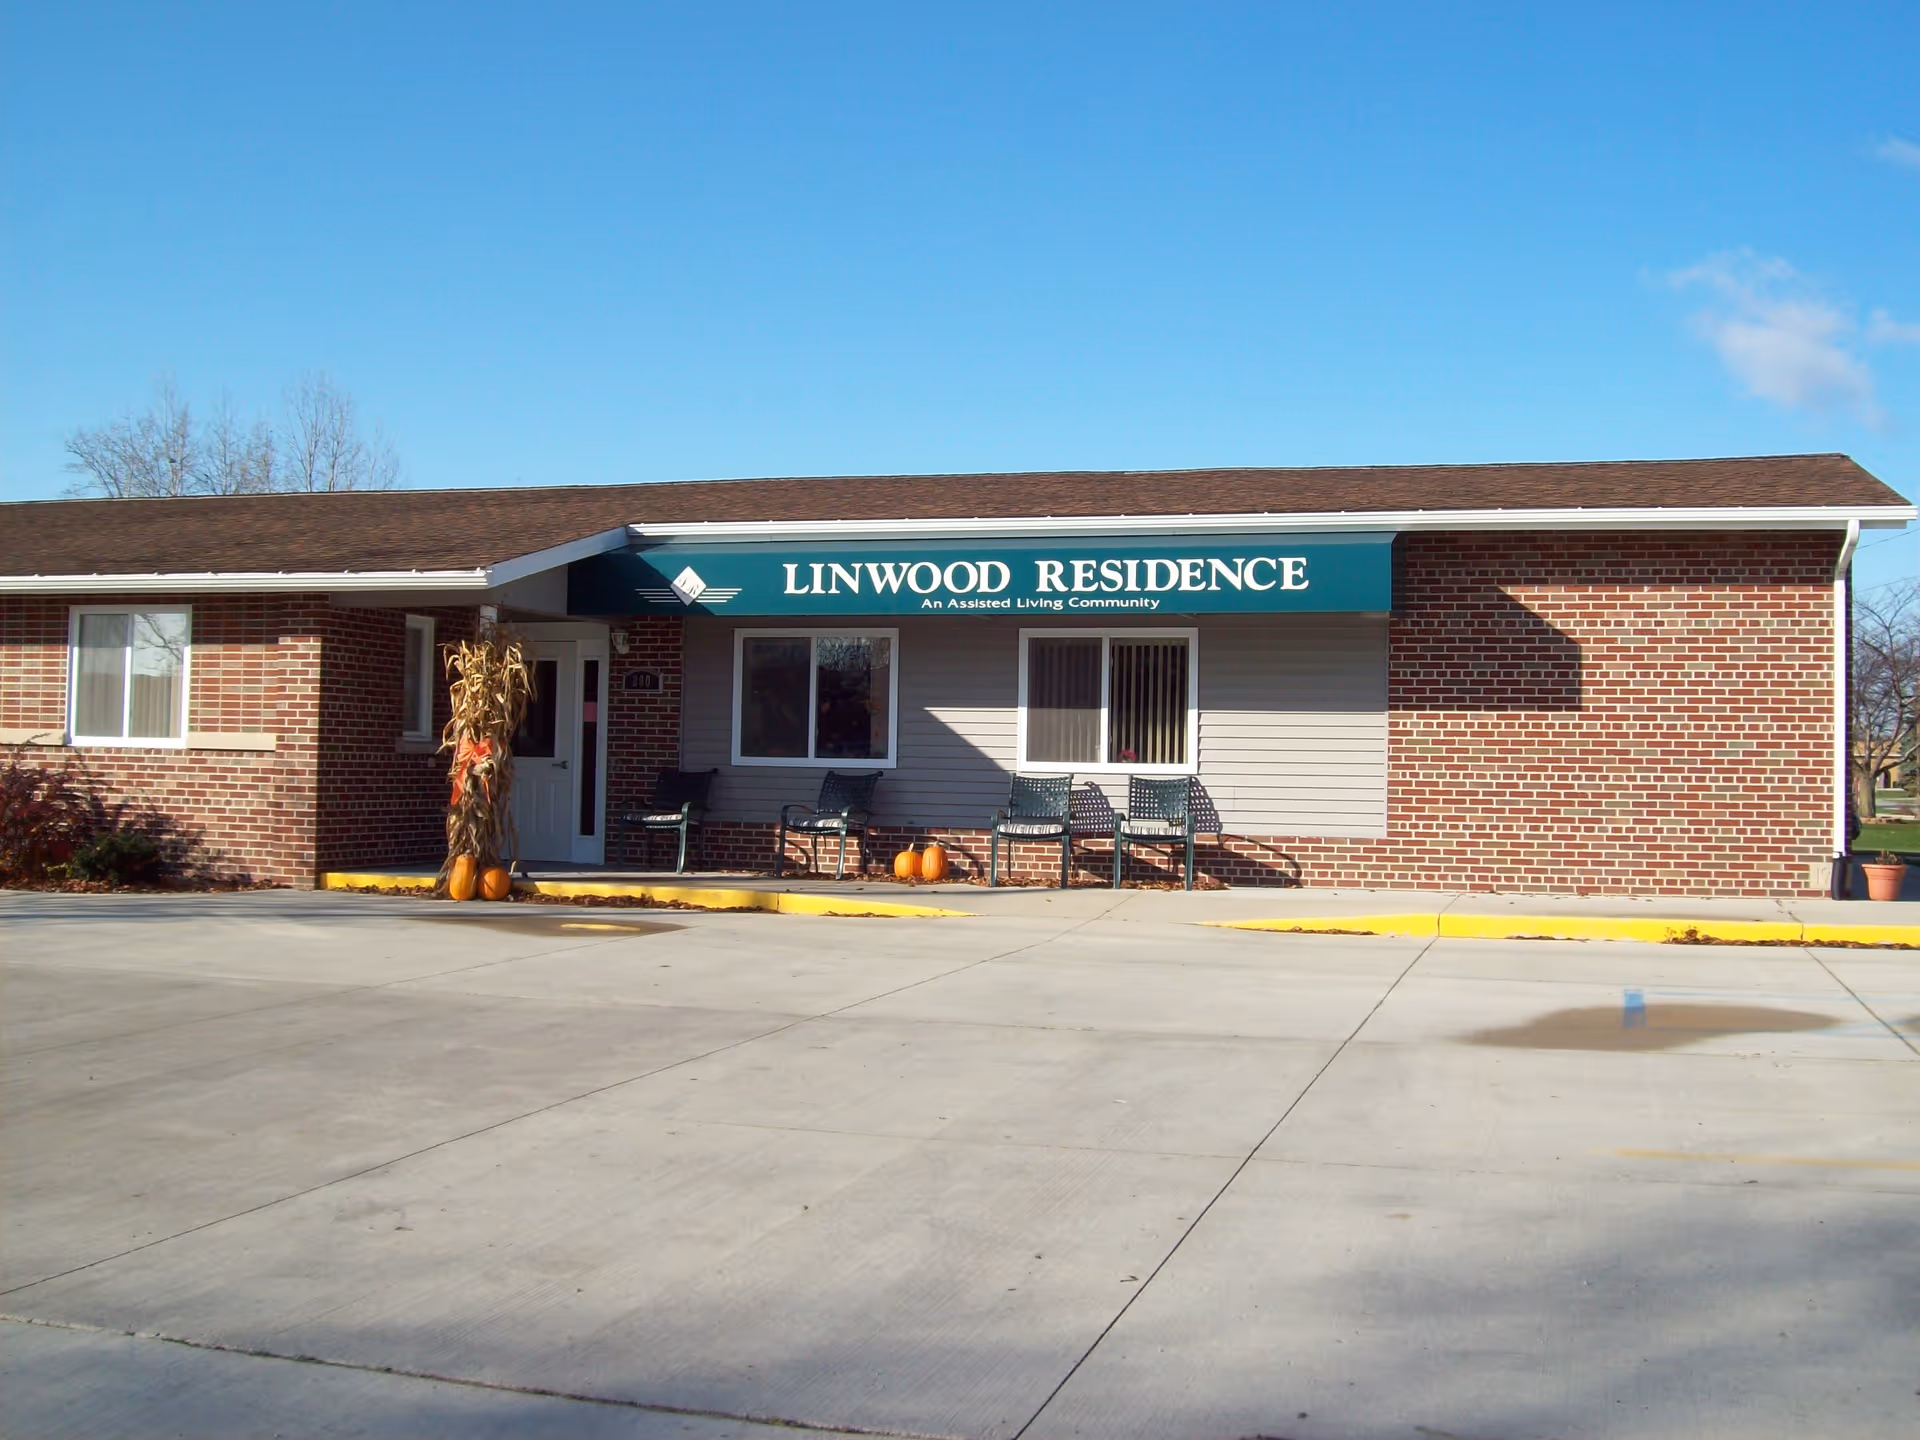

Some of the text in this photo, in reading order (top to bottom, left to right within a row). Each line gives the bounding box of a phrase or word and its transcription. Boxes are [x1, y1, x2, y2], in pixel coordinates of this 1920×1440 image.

[783, 557, 1310, 595] LINWOOD RESIDENCE
[922, 597, 1160, 611] An Assisted Living Community
